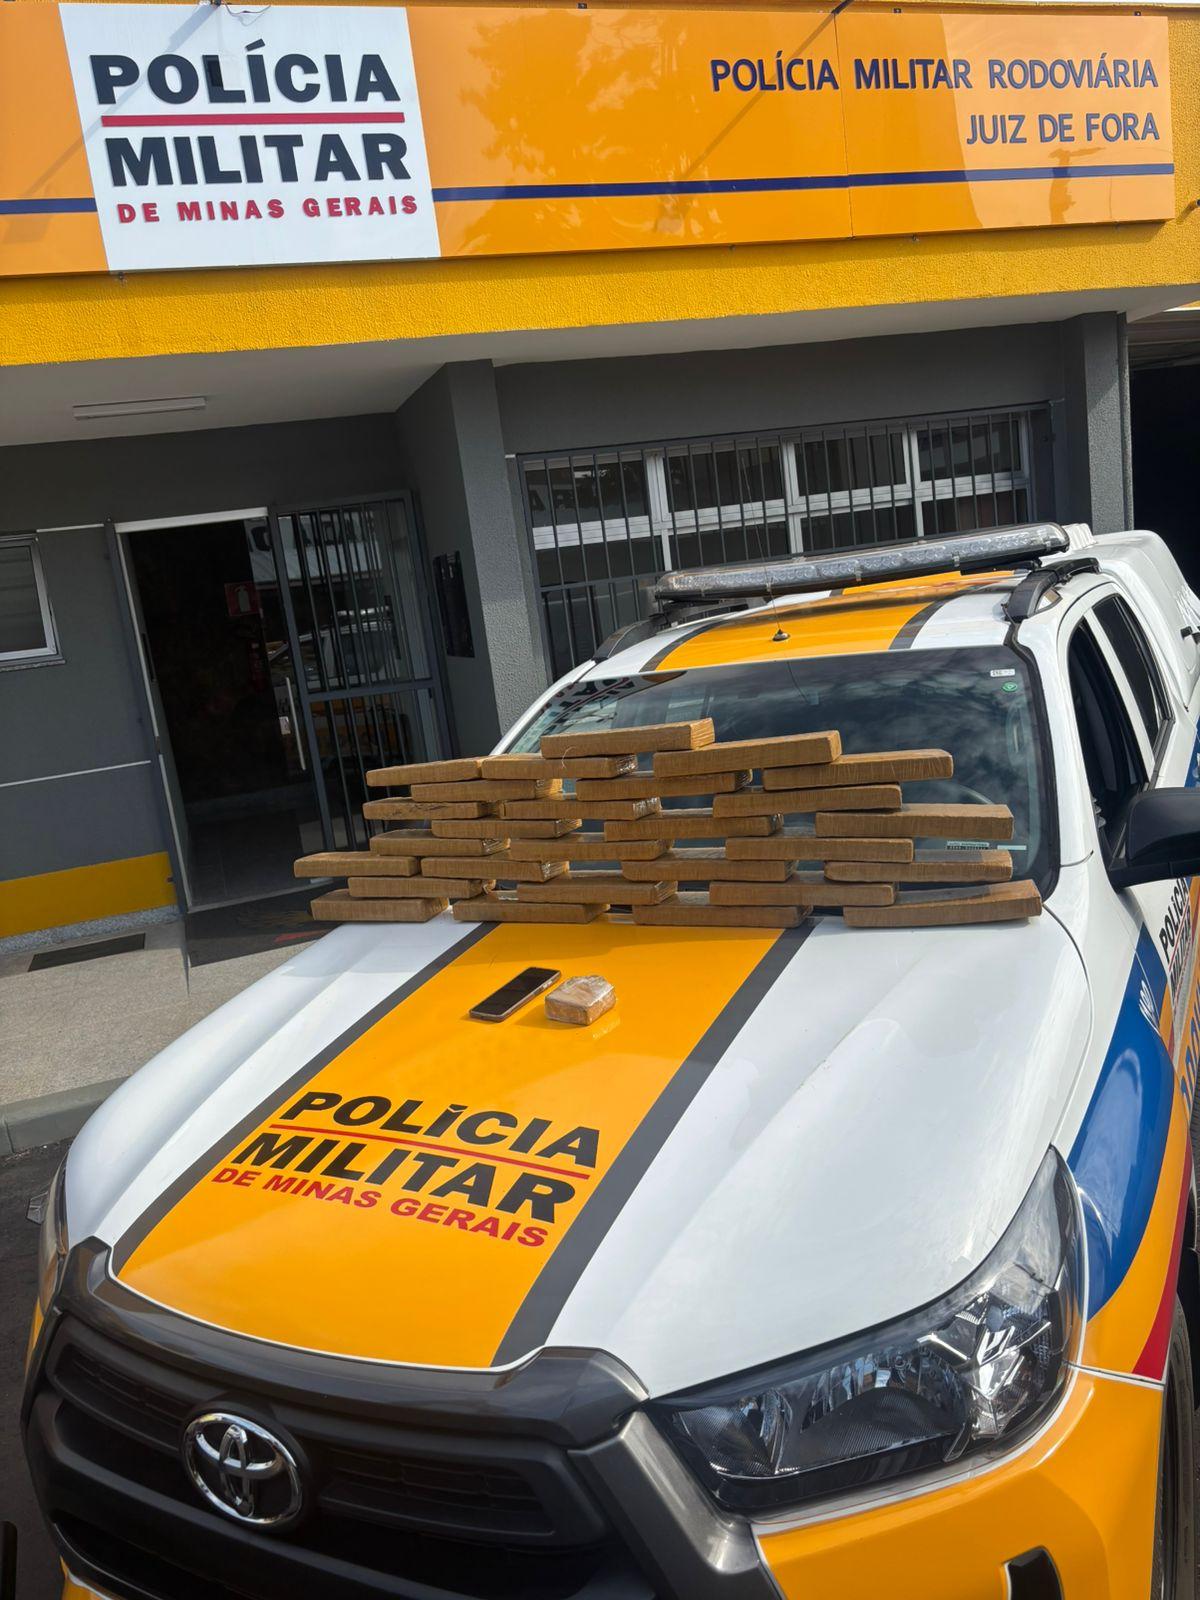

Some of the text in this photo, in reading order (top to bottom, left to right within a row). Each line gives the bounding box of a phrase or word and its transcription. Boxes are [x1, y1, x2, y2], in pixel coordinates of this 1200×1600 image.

[90, 38, 401, 105] POLÍCIA
[710, 51, 1159, 92] POLÍCIA MILITAR RODOVIÁRIA
[966, 112, 1160, 145] JUIZ DE FORA
[105, 133, 411, 187] MILITAR
[117, 196, 418, 224] DE MINAS GERAIS
[279, 1091, 600, 1169] POLÍCIA
[211, 1167, 549, 1248] DE MINAS GERAIS
[231, 1132, 576, 1224] MILITAR
